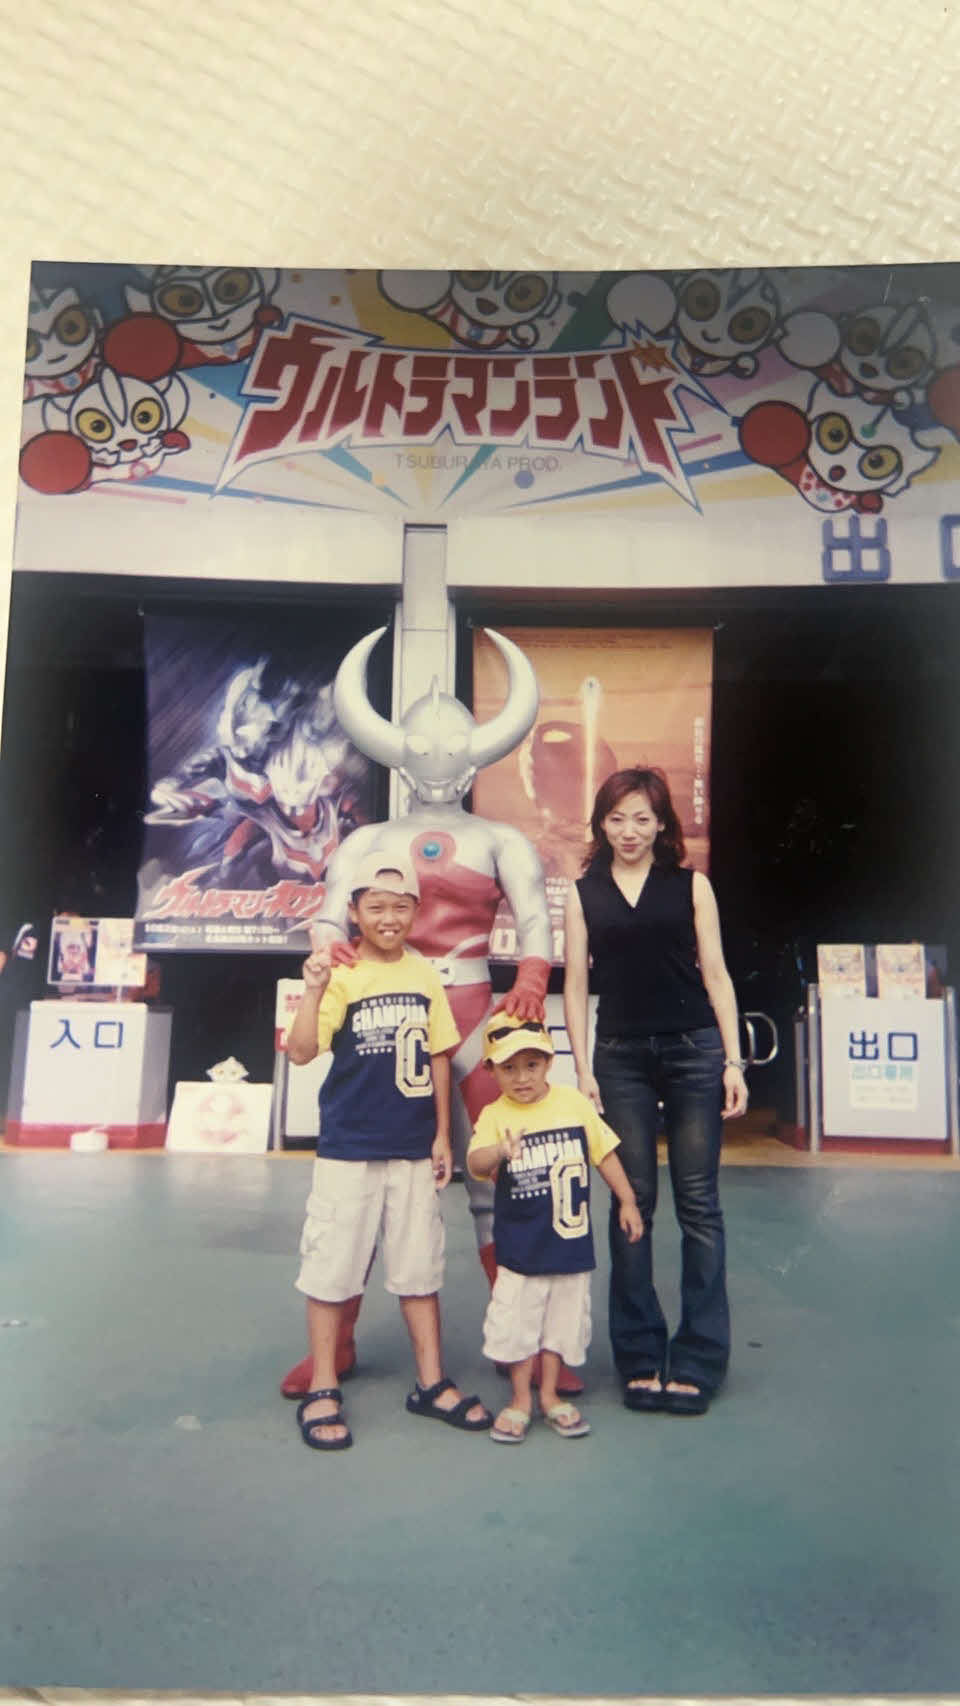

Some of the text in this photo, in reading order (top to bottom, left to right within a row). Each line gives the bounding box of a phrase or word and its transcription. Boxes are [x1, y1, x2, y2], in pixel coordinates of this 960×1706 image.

[234, 321, 682, 478] ウルトラマンランド
[50, 1019, 124, 1049] 入口
[395, 1018, 433, 1098] C
[849, 1029, 918, 1061] 出口
[549, 1158, 589, 1240] C
